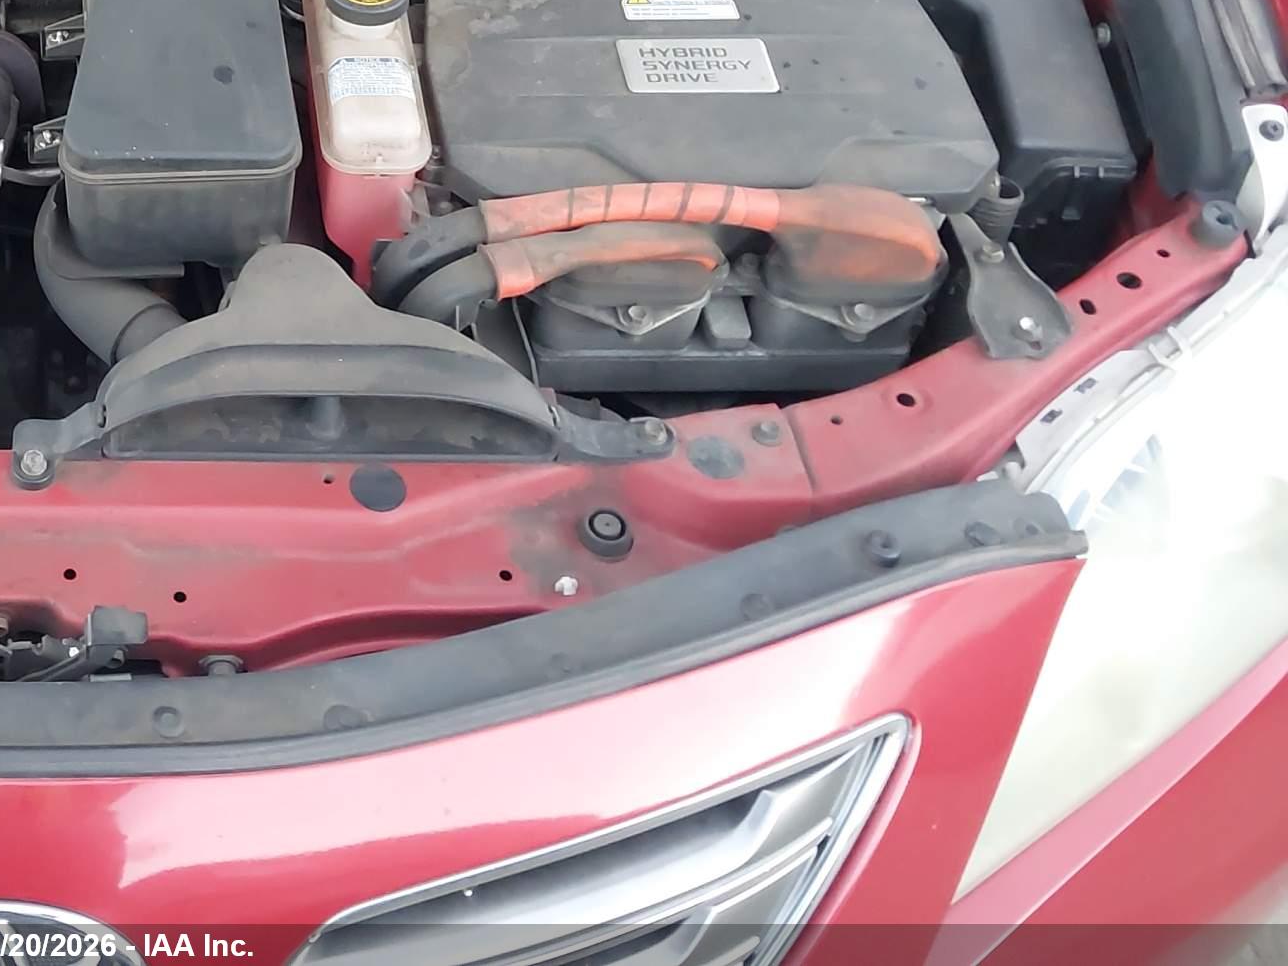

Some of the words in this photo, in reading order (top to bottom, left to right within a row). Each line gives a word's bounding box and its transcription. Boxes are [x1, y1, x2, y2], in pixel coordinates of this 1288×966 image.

[638, 47, 728, 58] HYBRID
[642, 59, 752, 71] SYNERGY
[646, 72, 719, 83] DRIVE
